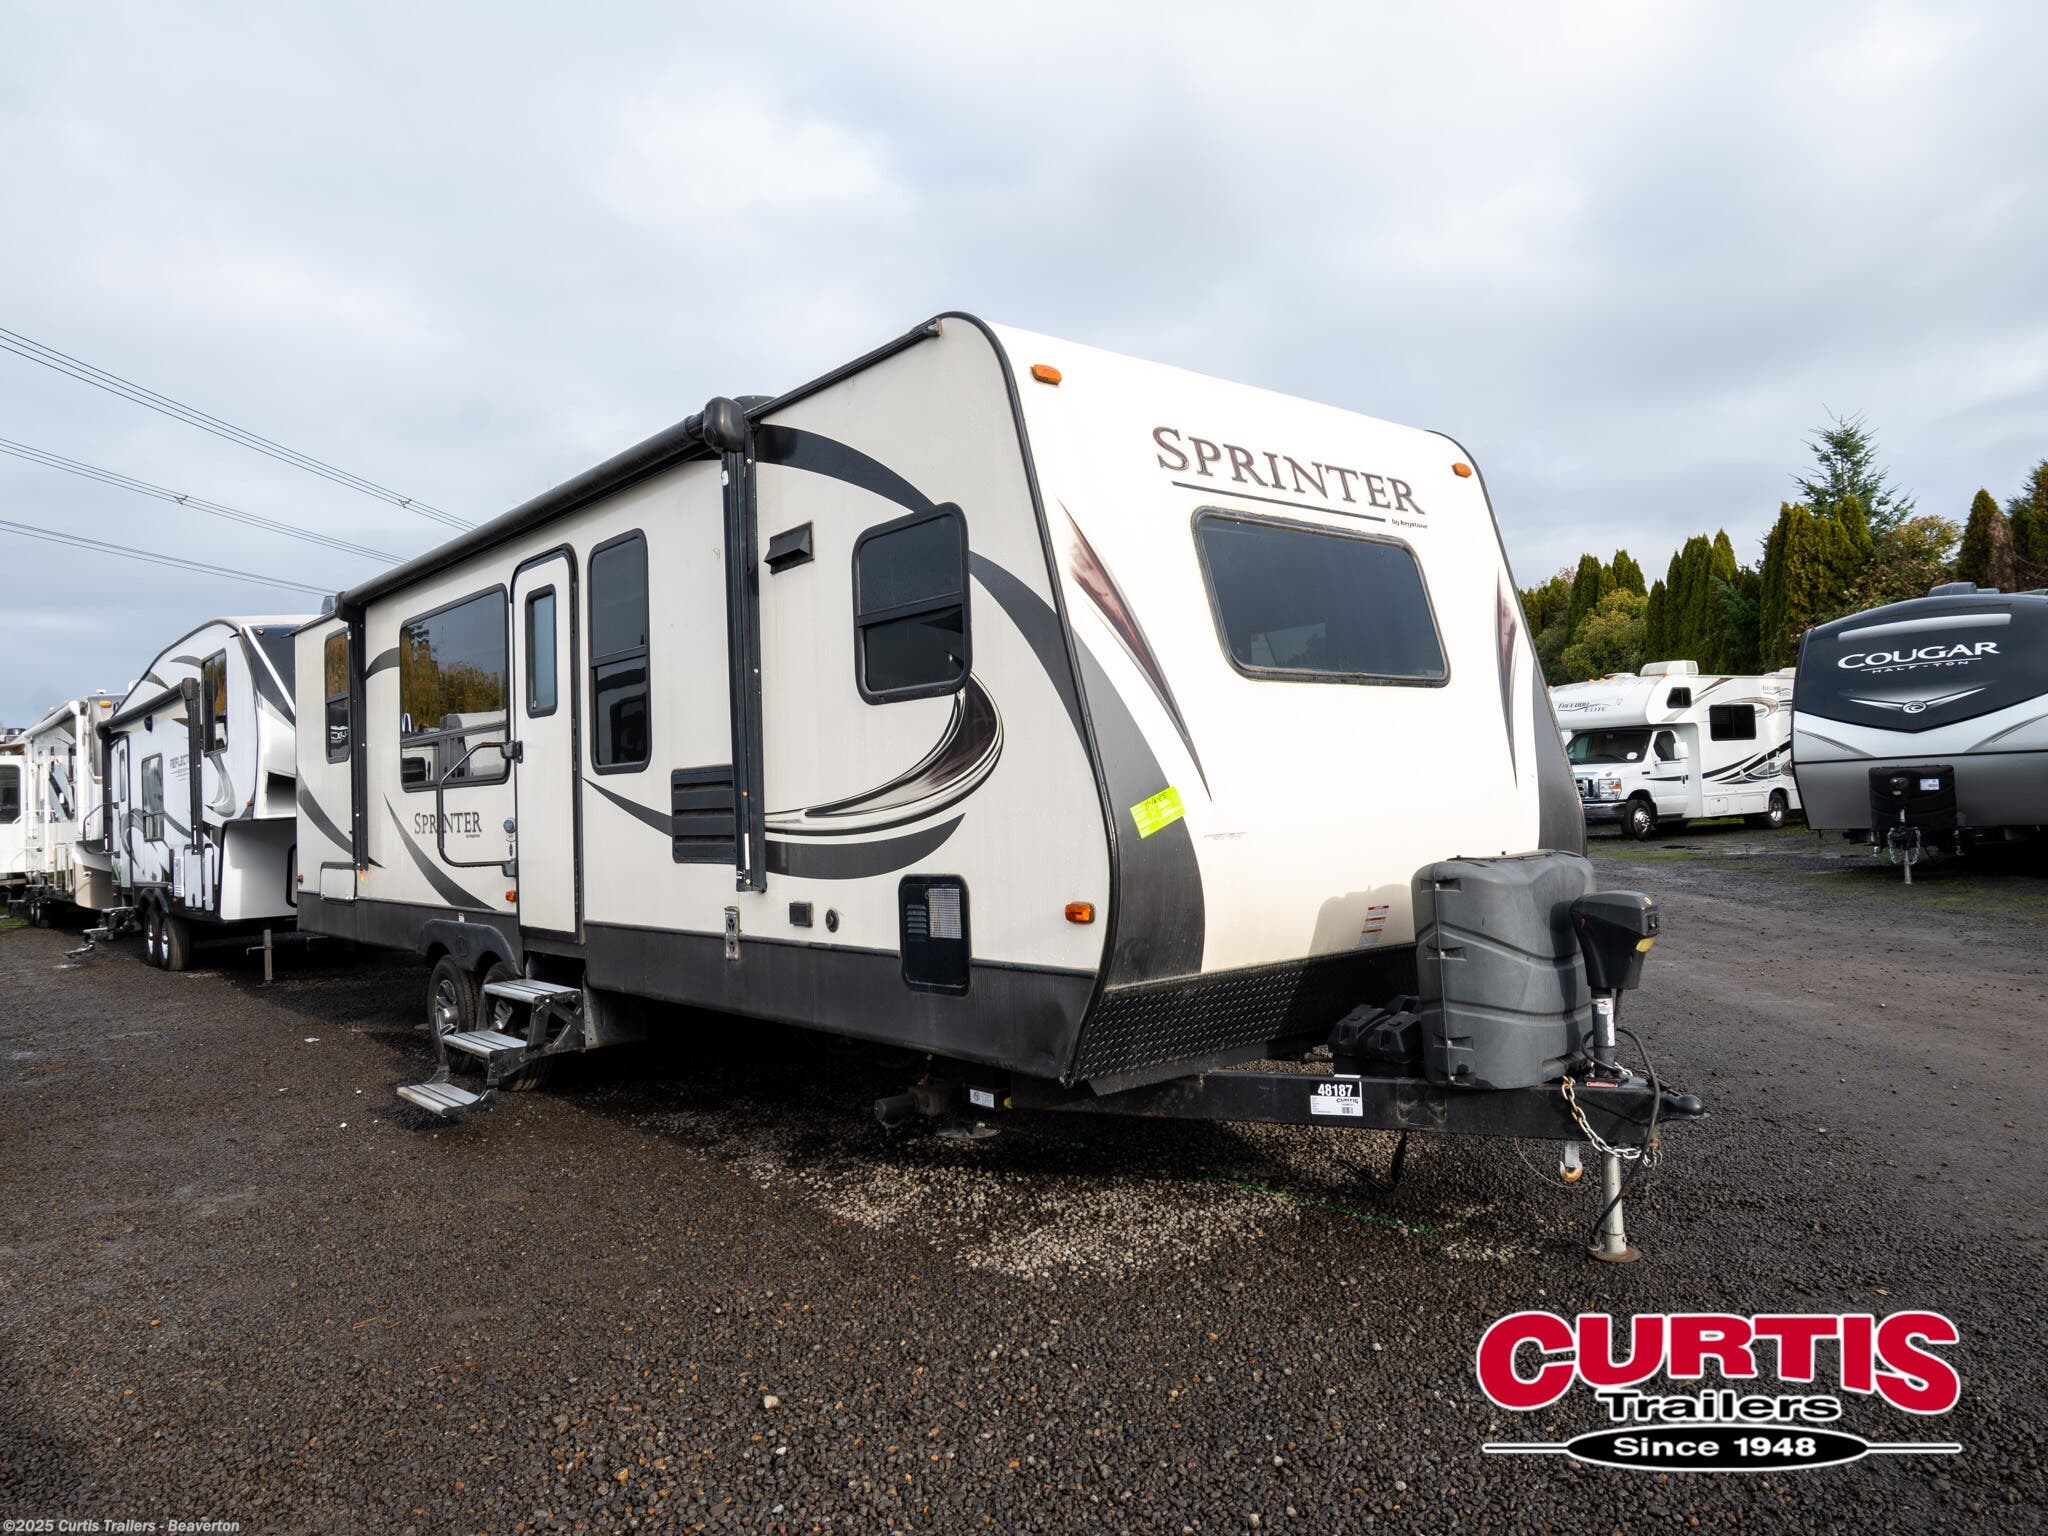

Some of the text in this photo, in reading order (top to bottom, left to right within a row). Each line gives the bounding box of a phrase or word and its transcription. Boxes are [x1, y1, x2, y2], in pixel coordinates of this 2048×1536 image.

[1152, 426, 1425, 515] SPRINTER
[1838, 641, 2000, 669] COUGAR
[414, 811, 482, 835] SPRNTER
[1317, 1083, 1353, 1098] 48187
